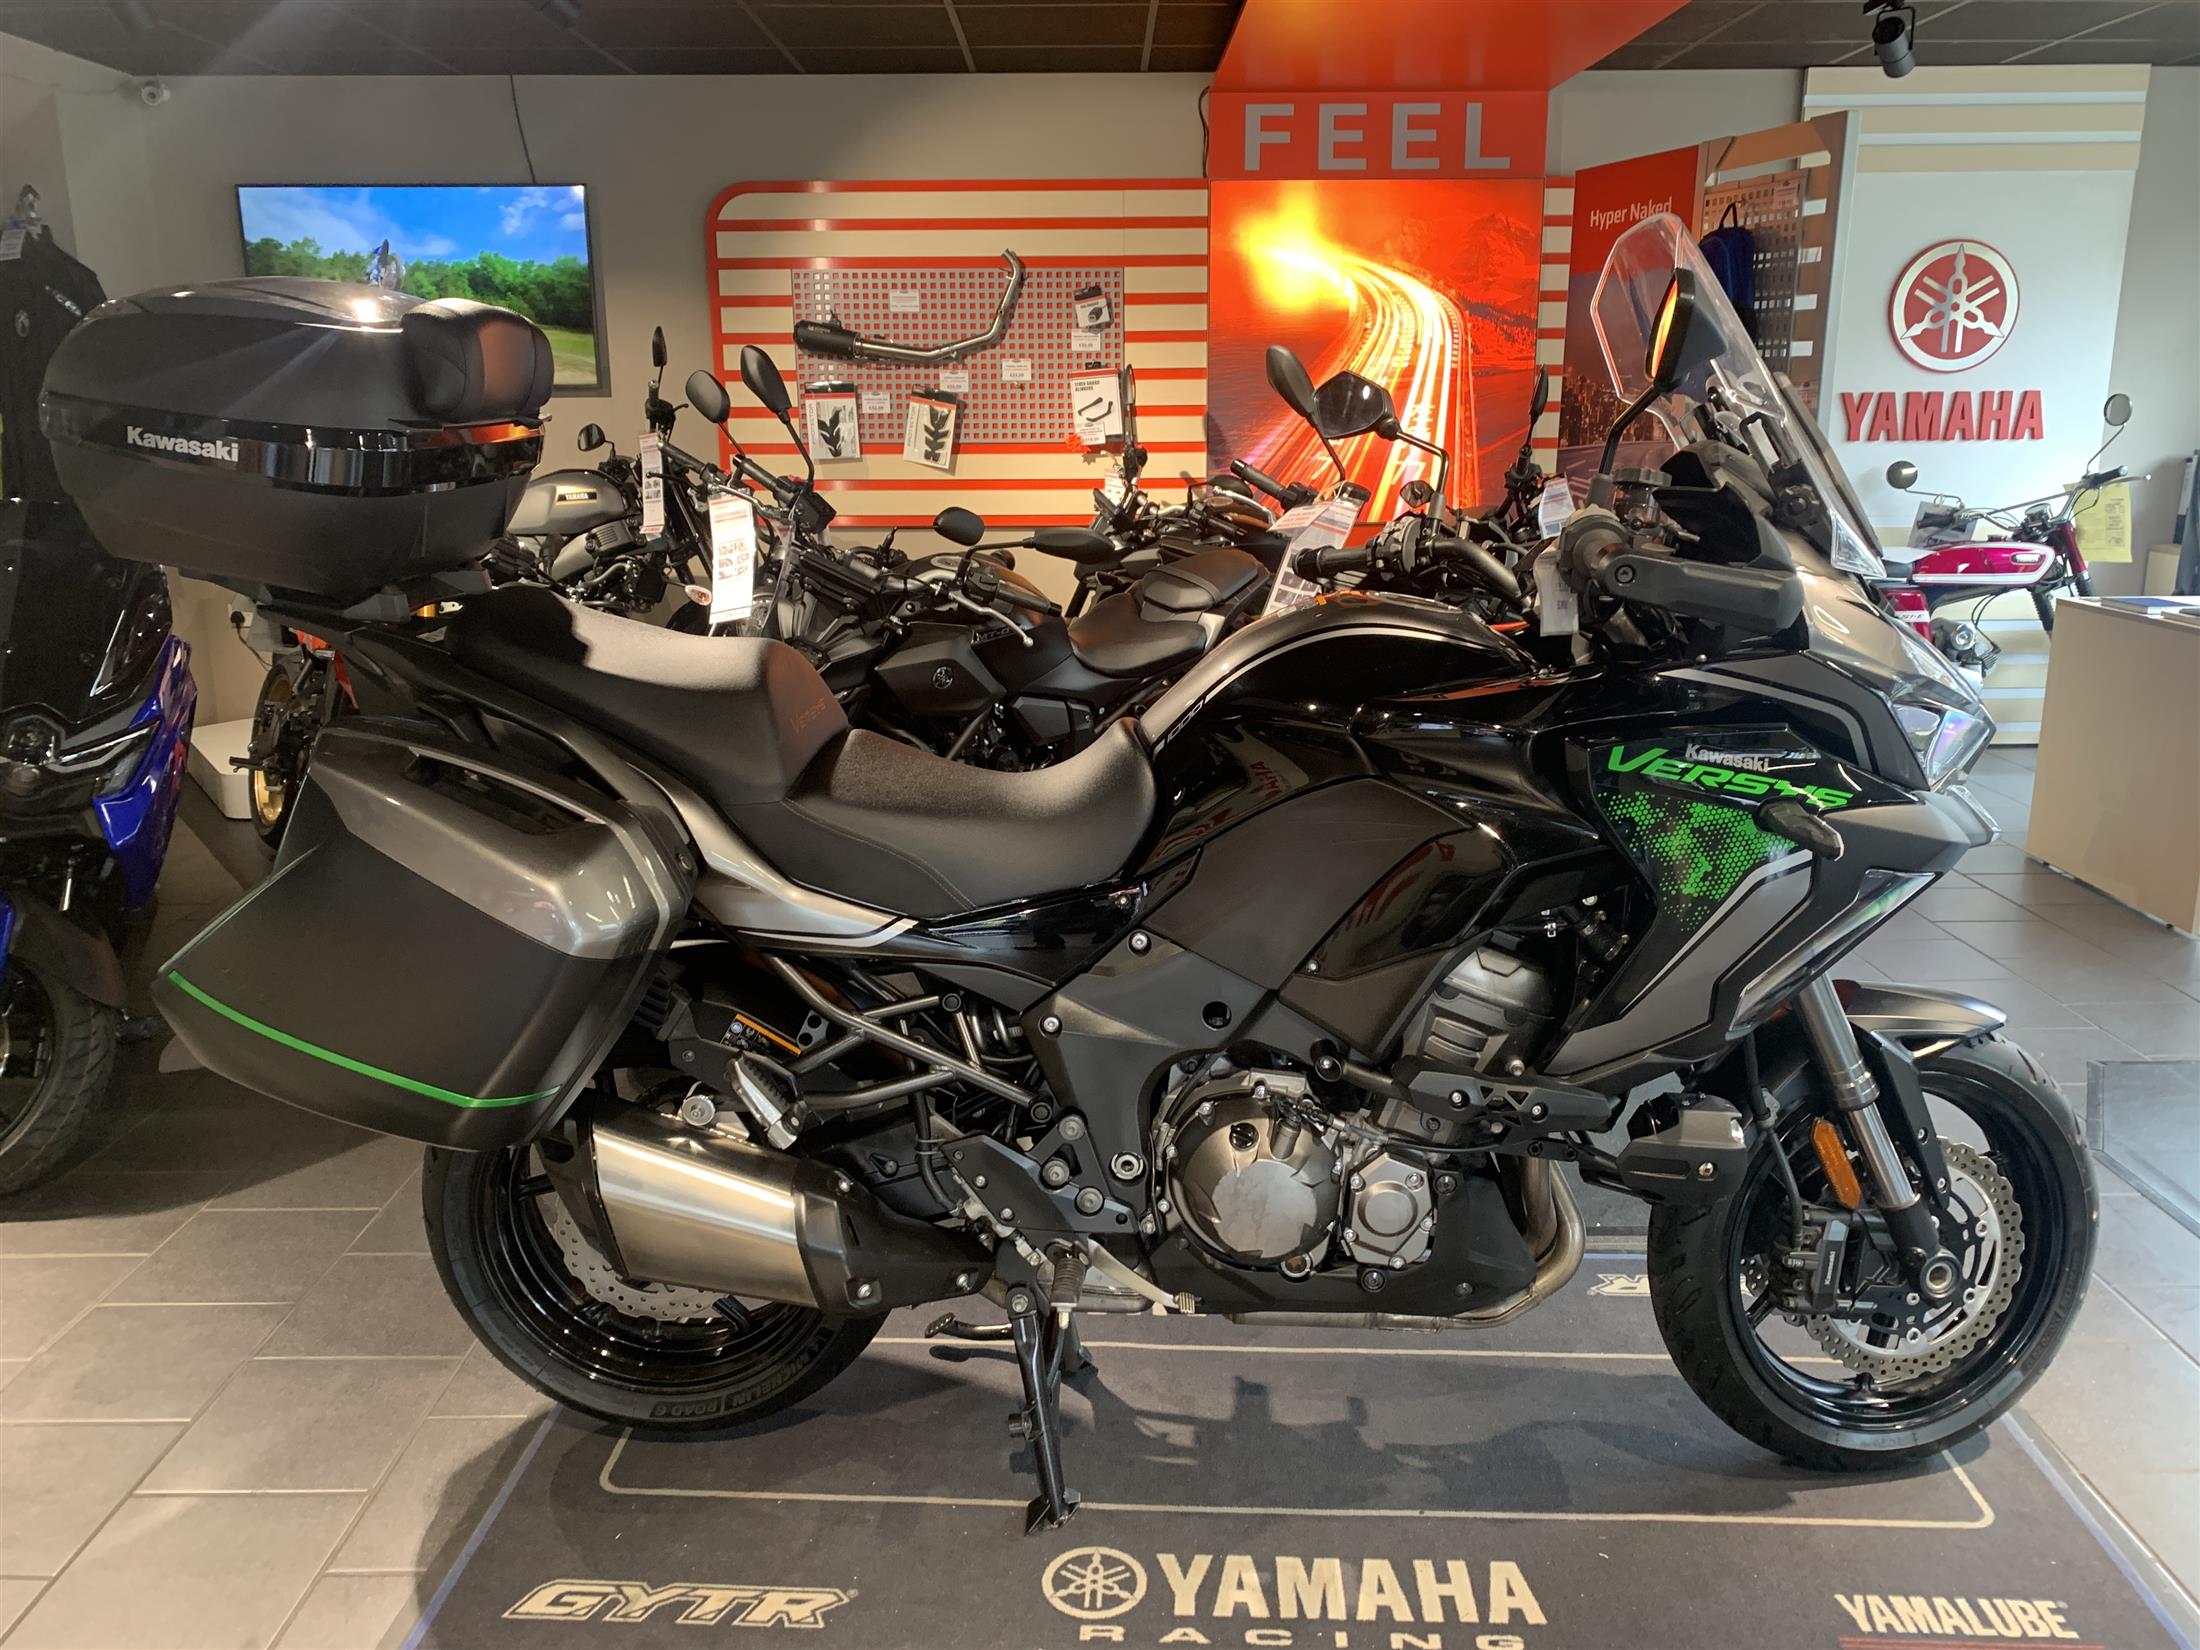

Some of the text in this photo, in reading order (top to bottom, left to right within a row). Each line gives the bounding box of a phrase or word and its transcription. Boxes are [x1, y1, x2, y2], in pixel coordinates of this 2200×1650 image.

[1244, 102, 1511, 171] FEEL
[1590, 196, 1672, 231] Hyper Naked
[1840, 390, 2044, 442] YAMAHA
[126, 425, 240, 463] Kawasaki
[976, 626, 1014, 643] MT-0
[1607, 745, 1854, 809] VERSYS
[1685, 743, 1770, 773] Kawasaki
[731, 1350, 811, 1408] MICHELIN
[655, 1401, 718, 1416] ROAD 6
[501, 1579, 848, 1628] GYTR
[1156, 1553, 1548, 1625] YAMAHA
[1079, 1624, 1525, 1650] RACING
[1834, 1593, 2080, 1639] YAMALUBE
